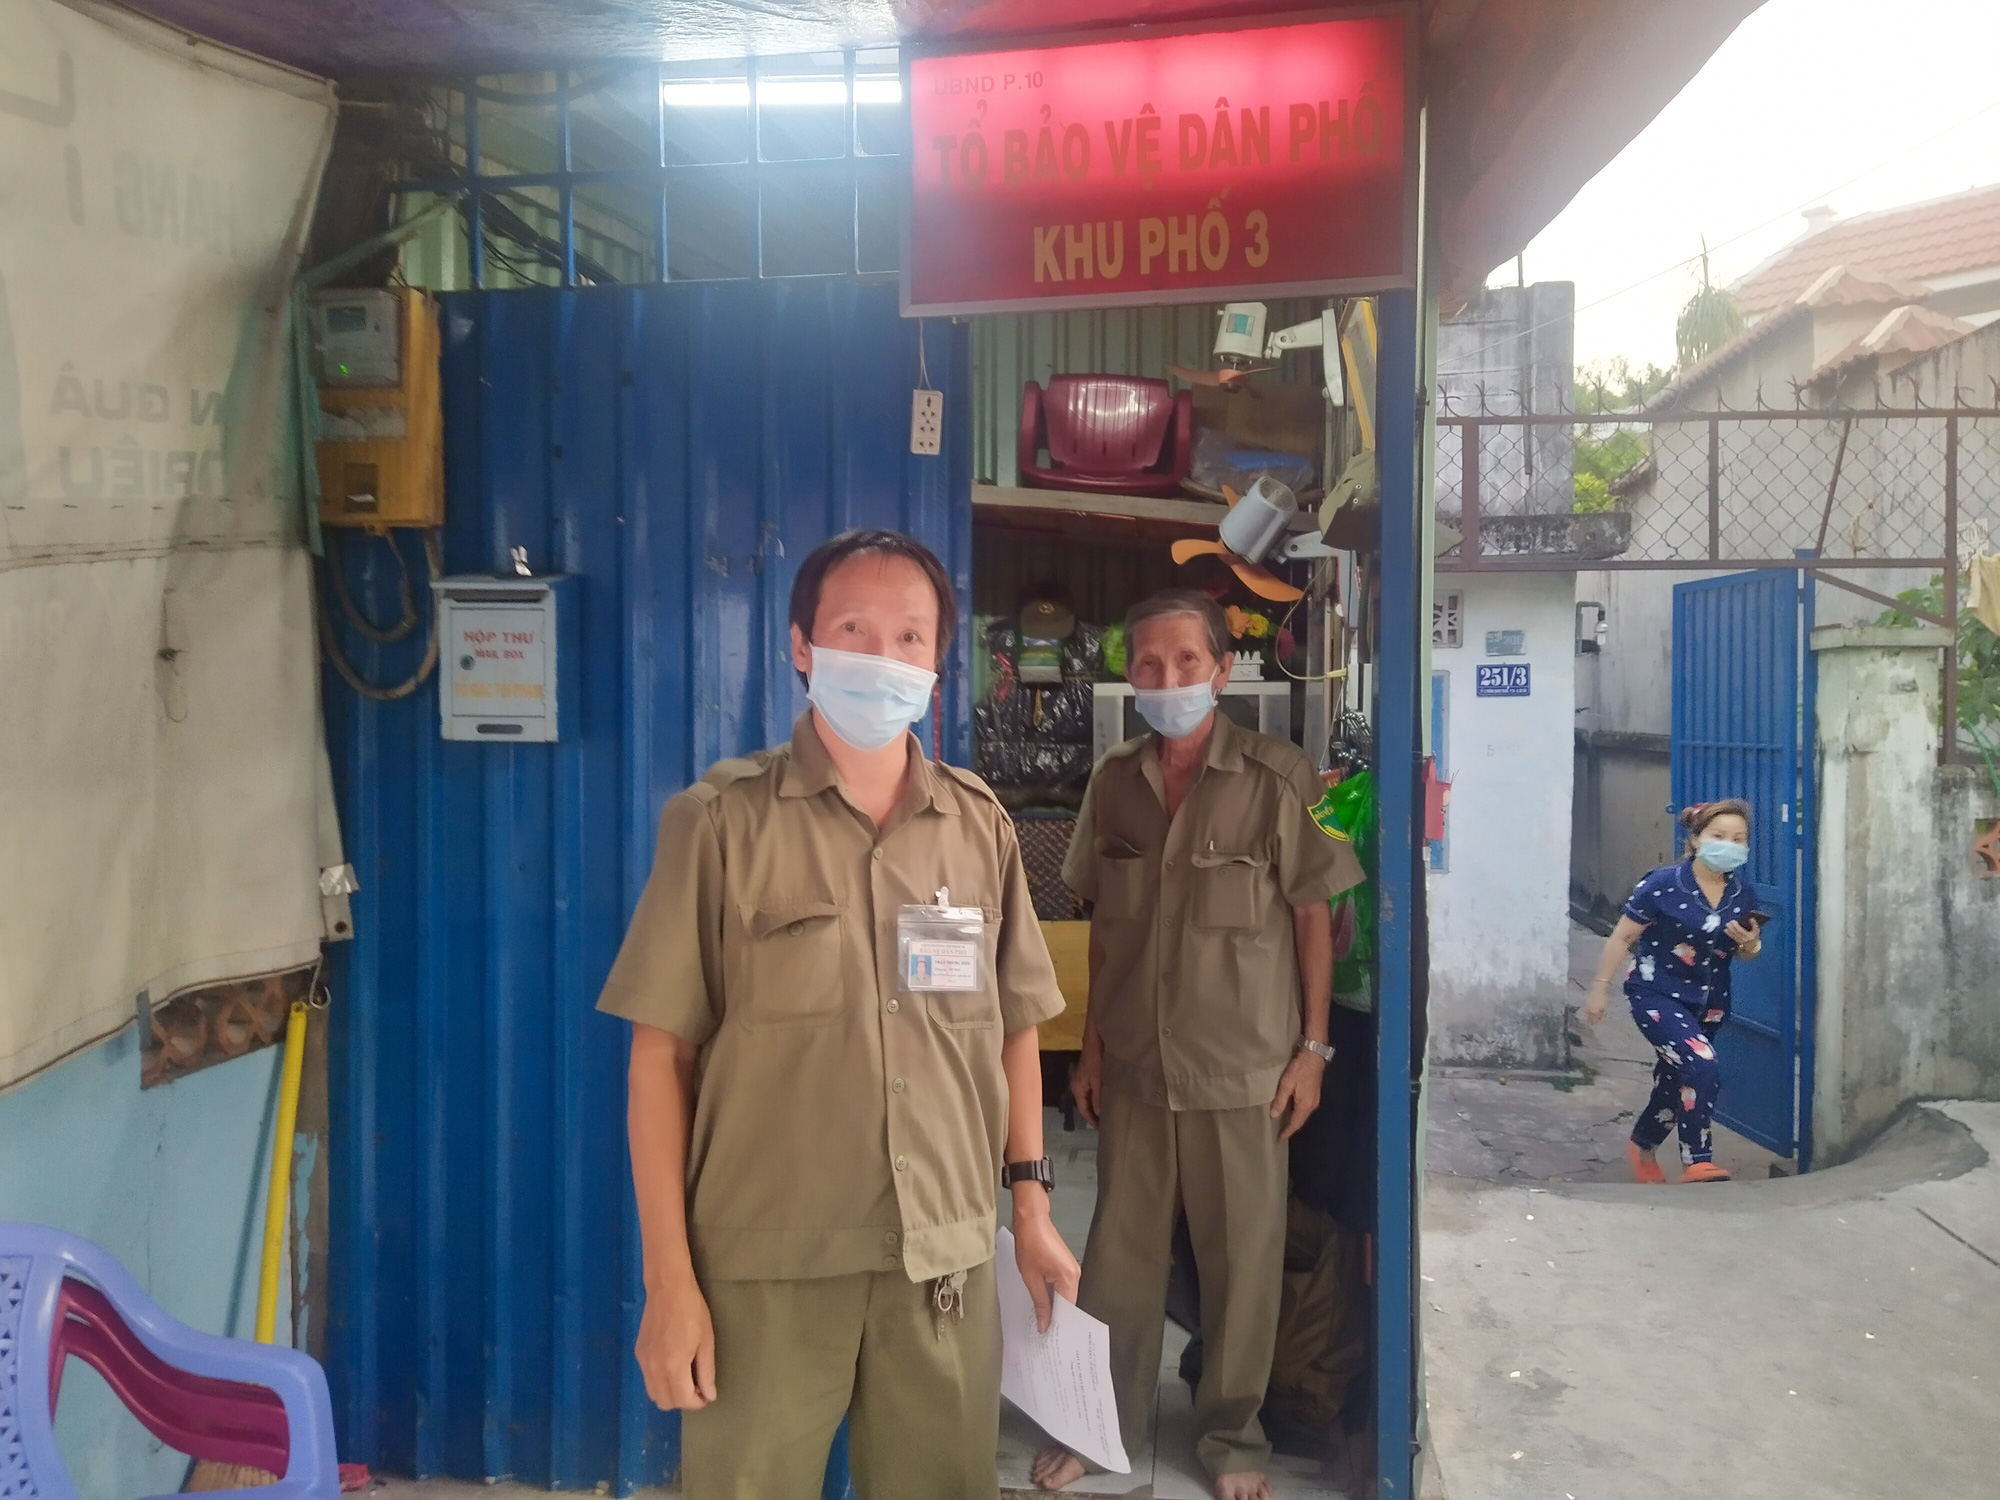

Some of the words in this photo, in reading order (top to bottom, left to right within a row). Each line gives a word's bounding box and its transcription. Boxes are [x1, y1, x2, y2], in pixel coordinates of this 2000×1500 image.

[934, 75, 995, 96] UBND
[1003, 71, 1044, 91] P.10
[932, 98, 988, 194] TỔ
[1004, 103, 1091, 188] BẢO
[1104, 102, 1162, 192] VỆ
[1179, 96, 1272, 173] DÂN
[1289, 74, 1386, 164] PHỐ
[1034, 221, 1124, 284] KHU
[1140, 185, 1231, 276] PHỐ
[1245, 209, 1270, 268] 3
[1480, 667, 1527, 687] 251/3
